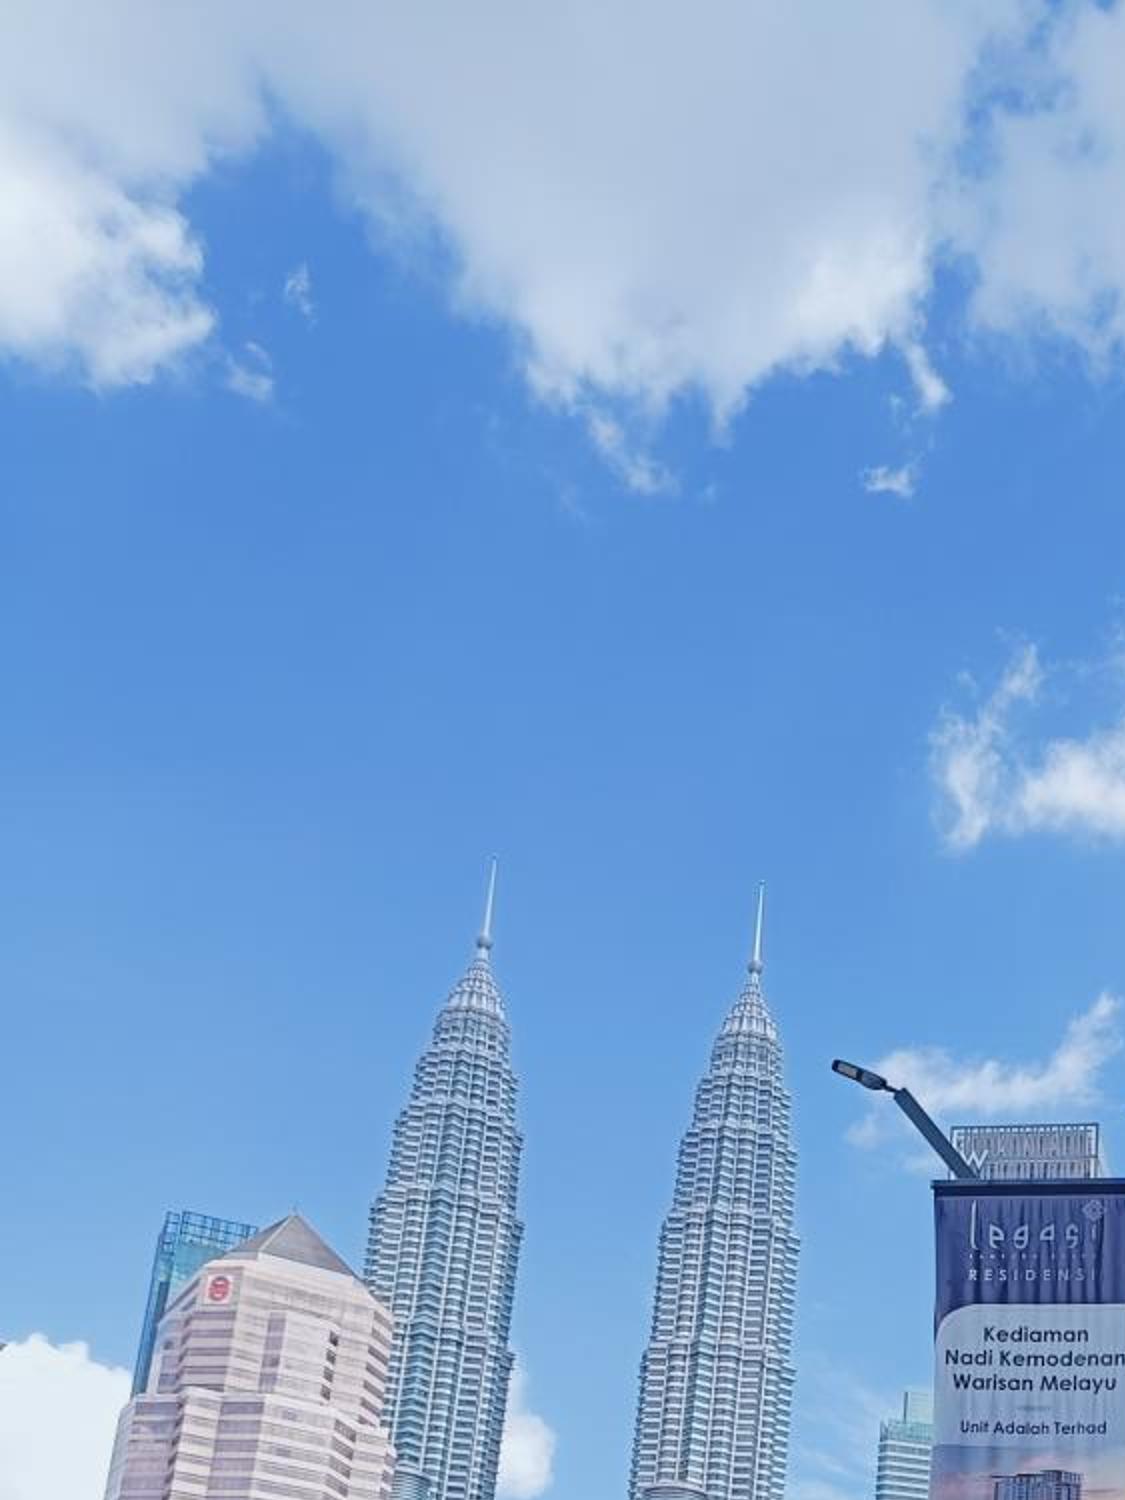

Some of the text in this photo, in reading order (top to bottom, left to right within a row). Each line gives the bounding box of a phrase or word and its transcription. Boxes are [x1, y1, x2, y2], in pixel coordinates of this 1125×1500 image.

[968, 1268, 1096, 1281] RESIDENSI
[983, 1325, 1089, 1343] Kediaman
[945, 1349, 993, 1366] Nadi
[953, 1373, 1117, 1395] Warisan Melayu
[960, 1420, 1107, 1435] Unit Adalah Terhad
